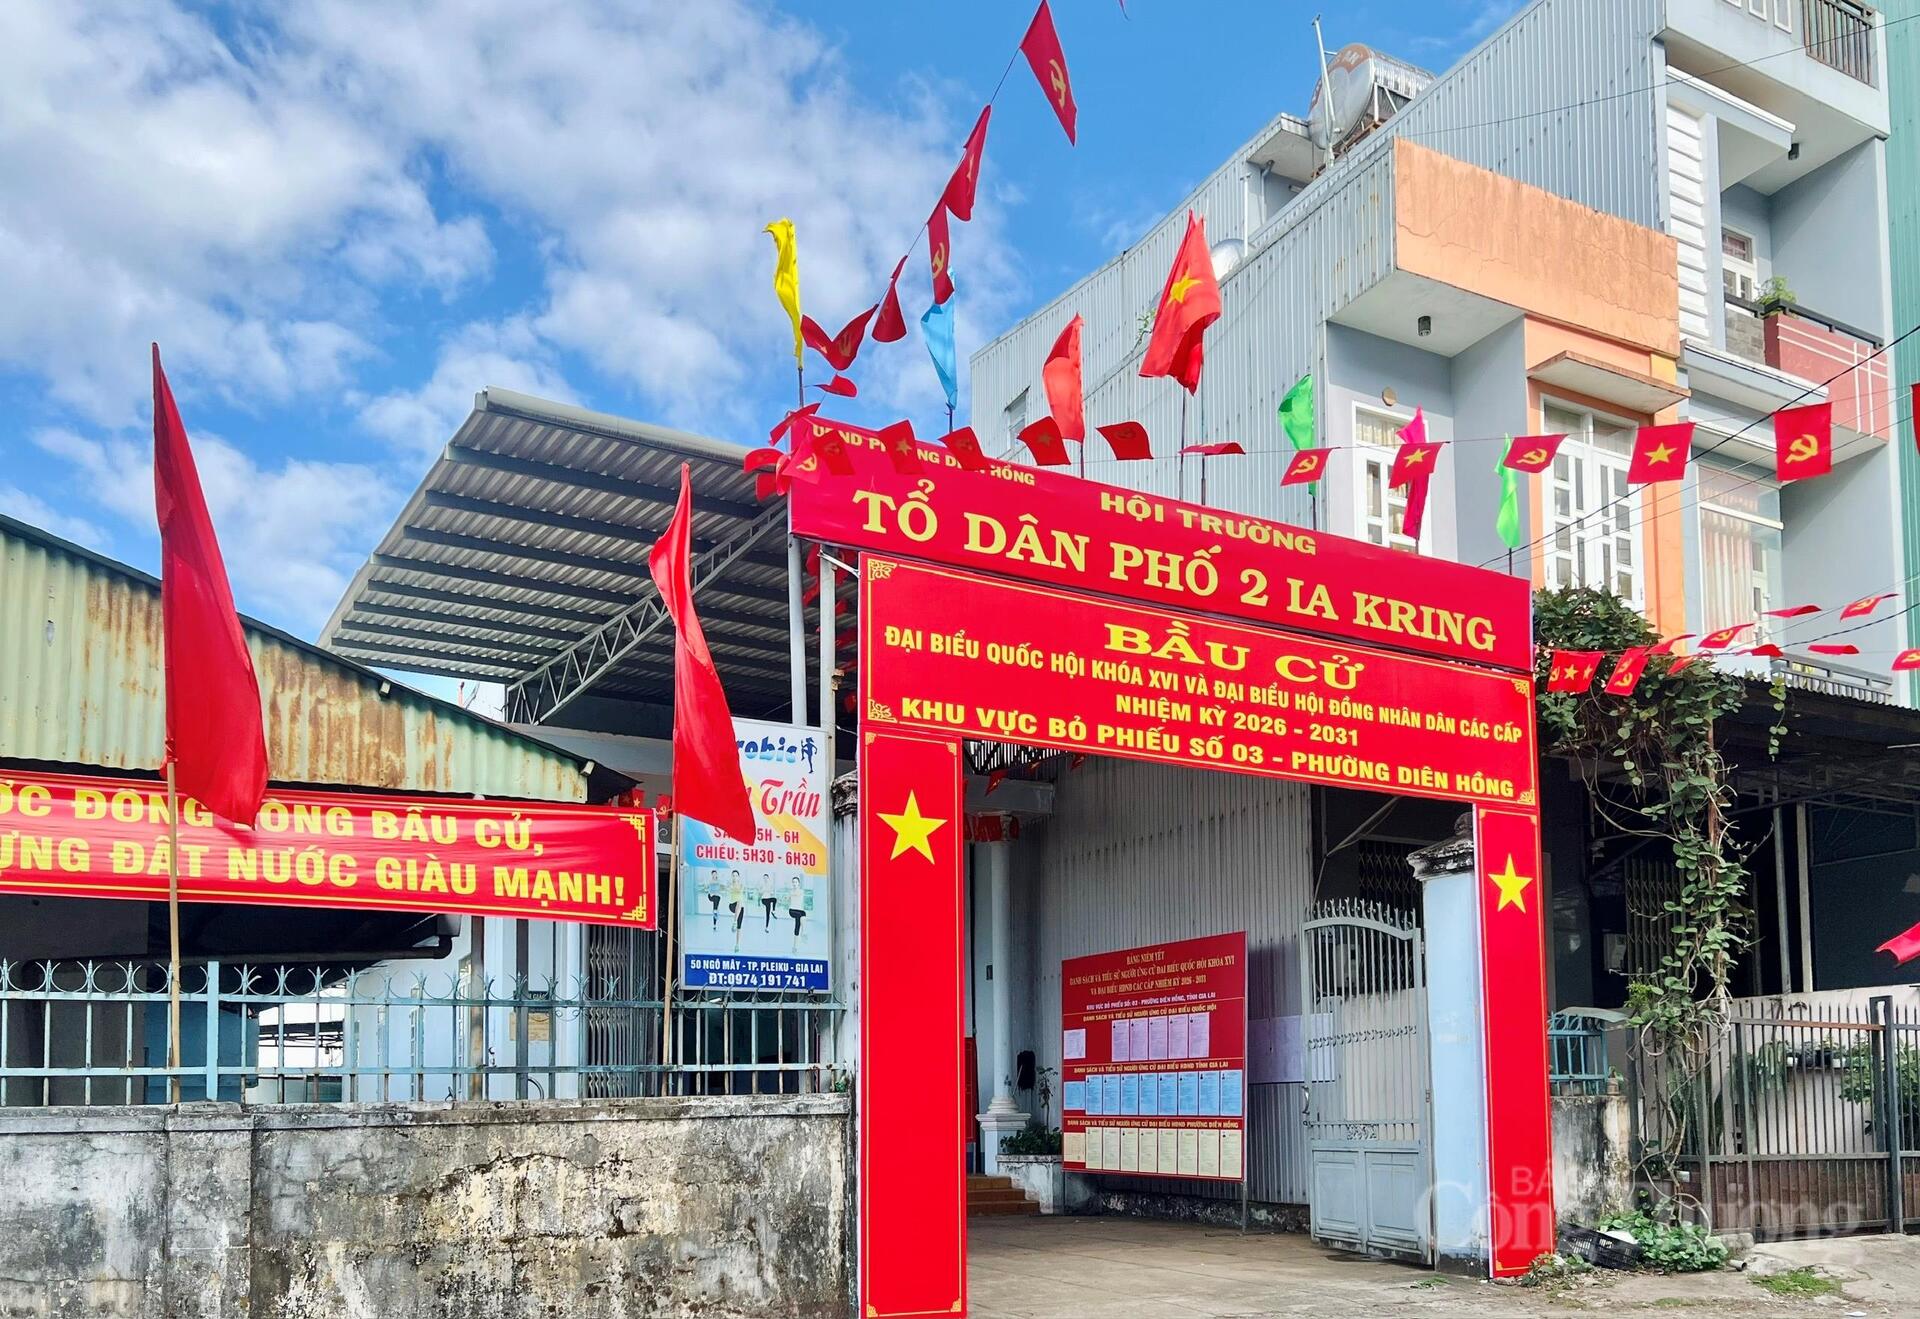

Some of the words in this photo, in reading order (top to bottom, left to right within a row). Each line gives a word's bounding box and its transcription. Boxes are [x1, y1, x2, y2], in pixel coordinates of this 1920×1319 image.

[812, 425, 863, 446] UND
[1101, 491, 1164, 522] HỘI
[1176, 509, 1317, 556] TRƯỜNG
[852, 478, 938, 541] TỔ
[964, 513, 1090, 572] DÂN
[1109, 544, 1221, 597] PHỐ
[1240, 568, 1269, 607] 2
[1352, 591, 1497, 652] KRING
[1104, 620, 1250, 671] BẦU
[1275, 654, 1365, 690] CỬ
[885, 625, 922, 653] ĐẠI
[930, 630, 979, 660] BIỂU
[986, 643, 1043, 669] QUỐC
[1051, 652, 1085, 679] HỘI
[1092, 660, 1143, 687] KHÓA
[1149, 669, 1178, 692] XVI
[1185, 673, 1208, 696] VÀ
[1213, 682, 1244, 704] ĐẠI
[1250, 682, 1289, 709] BIỂU
[1295, 691, 1324, 717] HỘI
[1329, 695, 1373, 721] ĐỒNG
[1379, 706, 1421, 729] NHÂN
[1425, 711, 1455, 734] DÂN
[1460, 717, 1489, 739] CÁC
[1494, 720, 1523, 743] CẤP
[1116, 694, 1191, 723] NHIỆM
[1199, 705, 1227, 726] KỲ
[1233, 712, 1287, 736] 2026
[1309, 723, 1359, 746] 2031
[902, 697, 965, 724] KHU
[976, 706, 1037, 736] VỰC
[1049, 715, 1087, 741] BỎ
[1098, 726, 1180, 754] PHIẾU
[1189, 735, 1224, 758] SỐ
[1232, 743, 1264, 764] 03
[1292, 751, 1390, 781] PHƯỜNG
[1398, 766, 1448, 789] DIÊN
[1456, 771, 1514, 797] HỒNG
[760, 778, 821, 818] Trần
[743, 848, 774, 864] 5H30
[786, 852, 816, 867] 6H30
[757, 828, 772, 841] 5H
[784, 831, 799, 844] 6H
[109, 833, 210, 878] ĐẤT
[228, 845, 358, 887] NƯỚC
[375, 853, 477, 895] GIÀU
[494, 866, 625, 907] MẠNH!
[690, 959, 701, 970] 50
[722, 959, 741, 971] MÂY
[761, 961, 788, 972] PLEIKU
[795, 962, 808, 973] GIA
[810, 963, 823, 974] LAI
[761, 974, 782, 986] 191
[785, 975, 806, 987] 741
